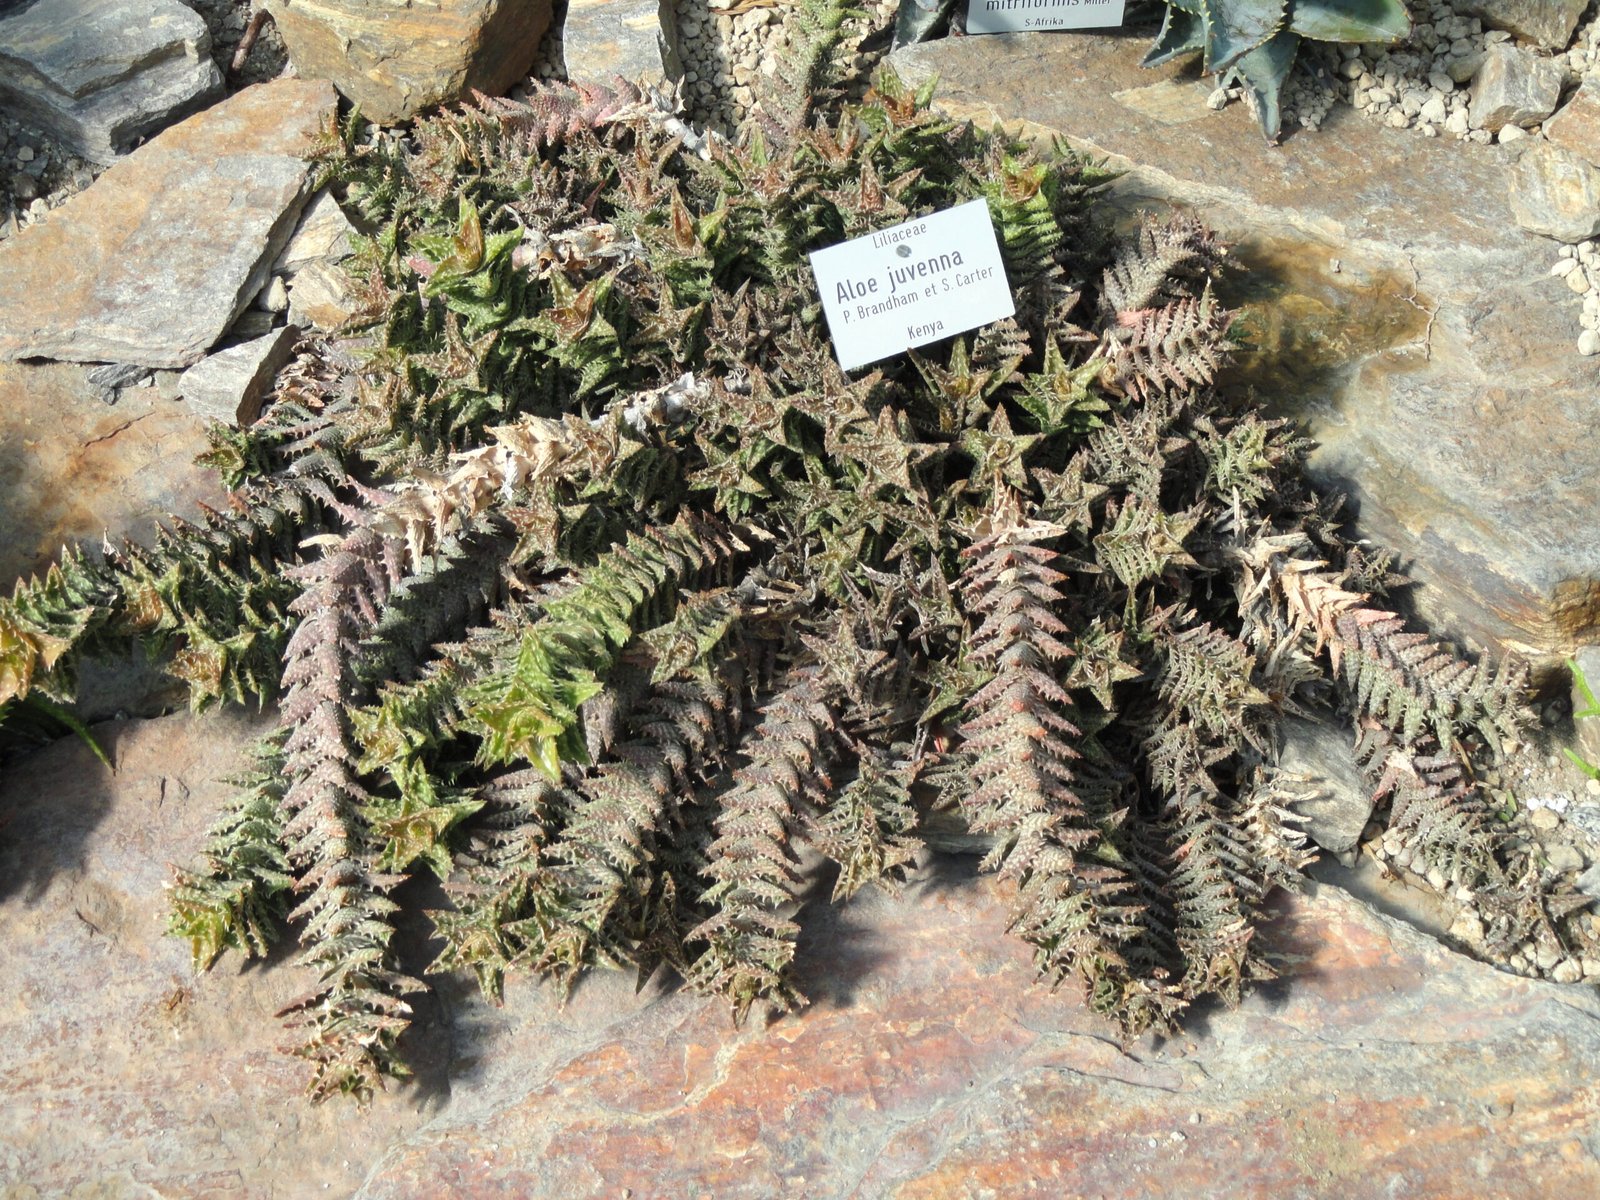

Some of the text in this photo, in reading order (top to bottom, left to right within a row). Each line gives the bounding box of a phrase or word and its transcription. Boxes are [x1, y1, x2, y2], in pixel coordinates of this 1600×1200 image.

[1025, 18, 1064, 27] S-Afrika
[873, 223, 927, 249] Liliaceae
[836, 250, 964, 304] Aloe juvenna
[843, 267, 994, 324] P. Brandham et S. Carter
[907, 320, 945, 340] Kenya
